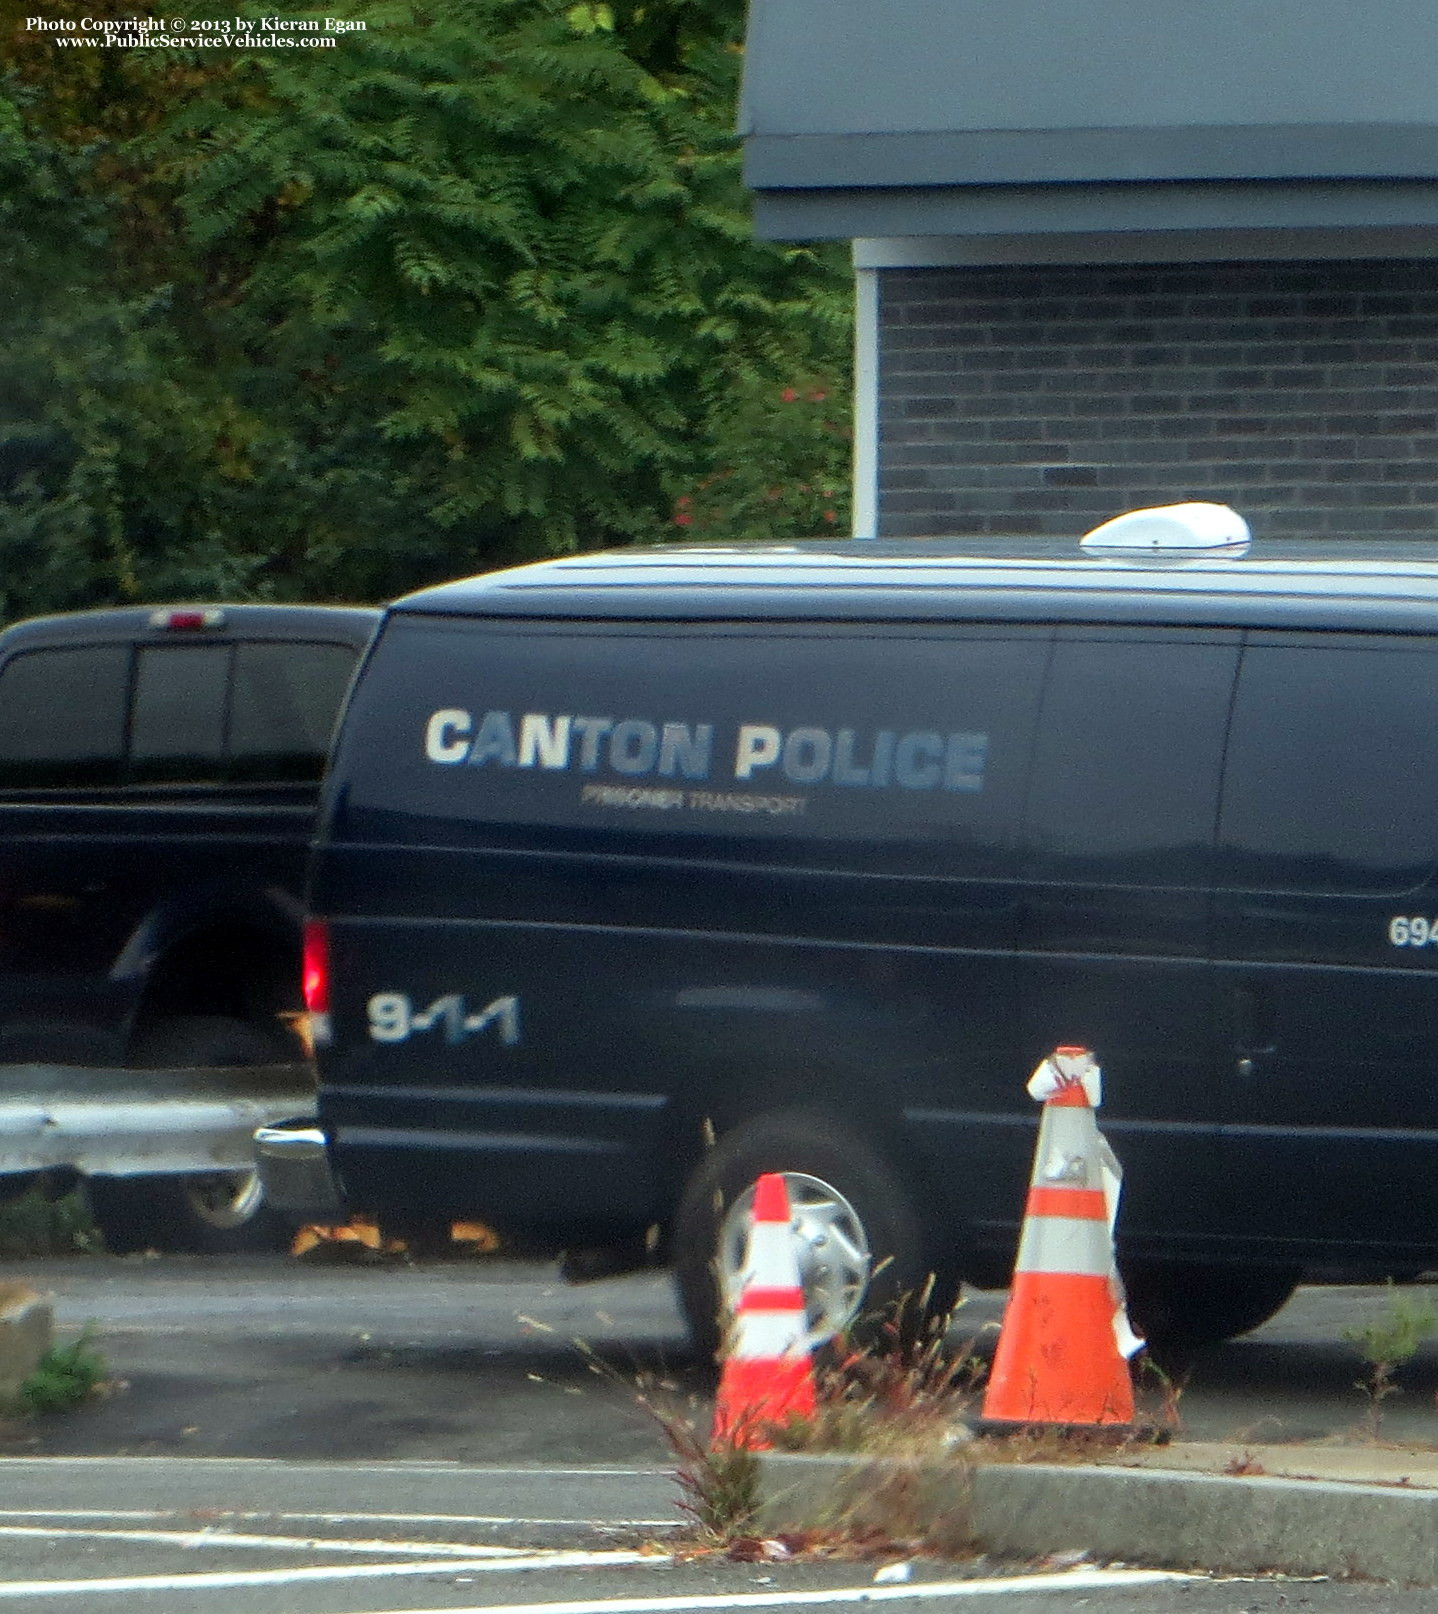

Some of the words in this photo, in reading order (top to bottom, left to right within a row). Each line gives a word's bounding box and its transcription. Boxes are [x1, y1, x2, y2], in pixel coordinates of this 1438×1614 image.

[424, 708, 712, 781] CANTON
[735, 725, 989, 792] POLICE
[367, 993, 520, 1043] 9-1-1
